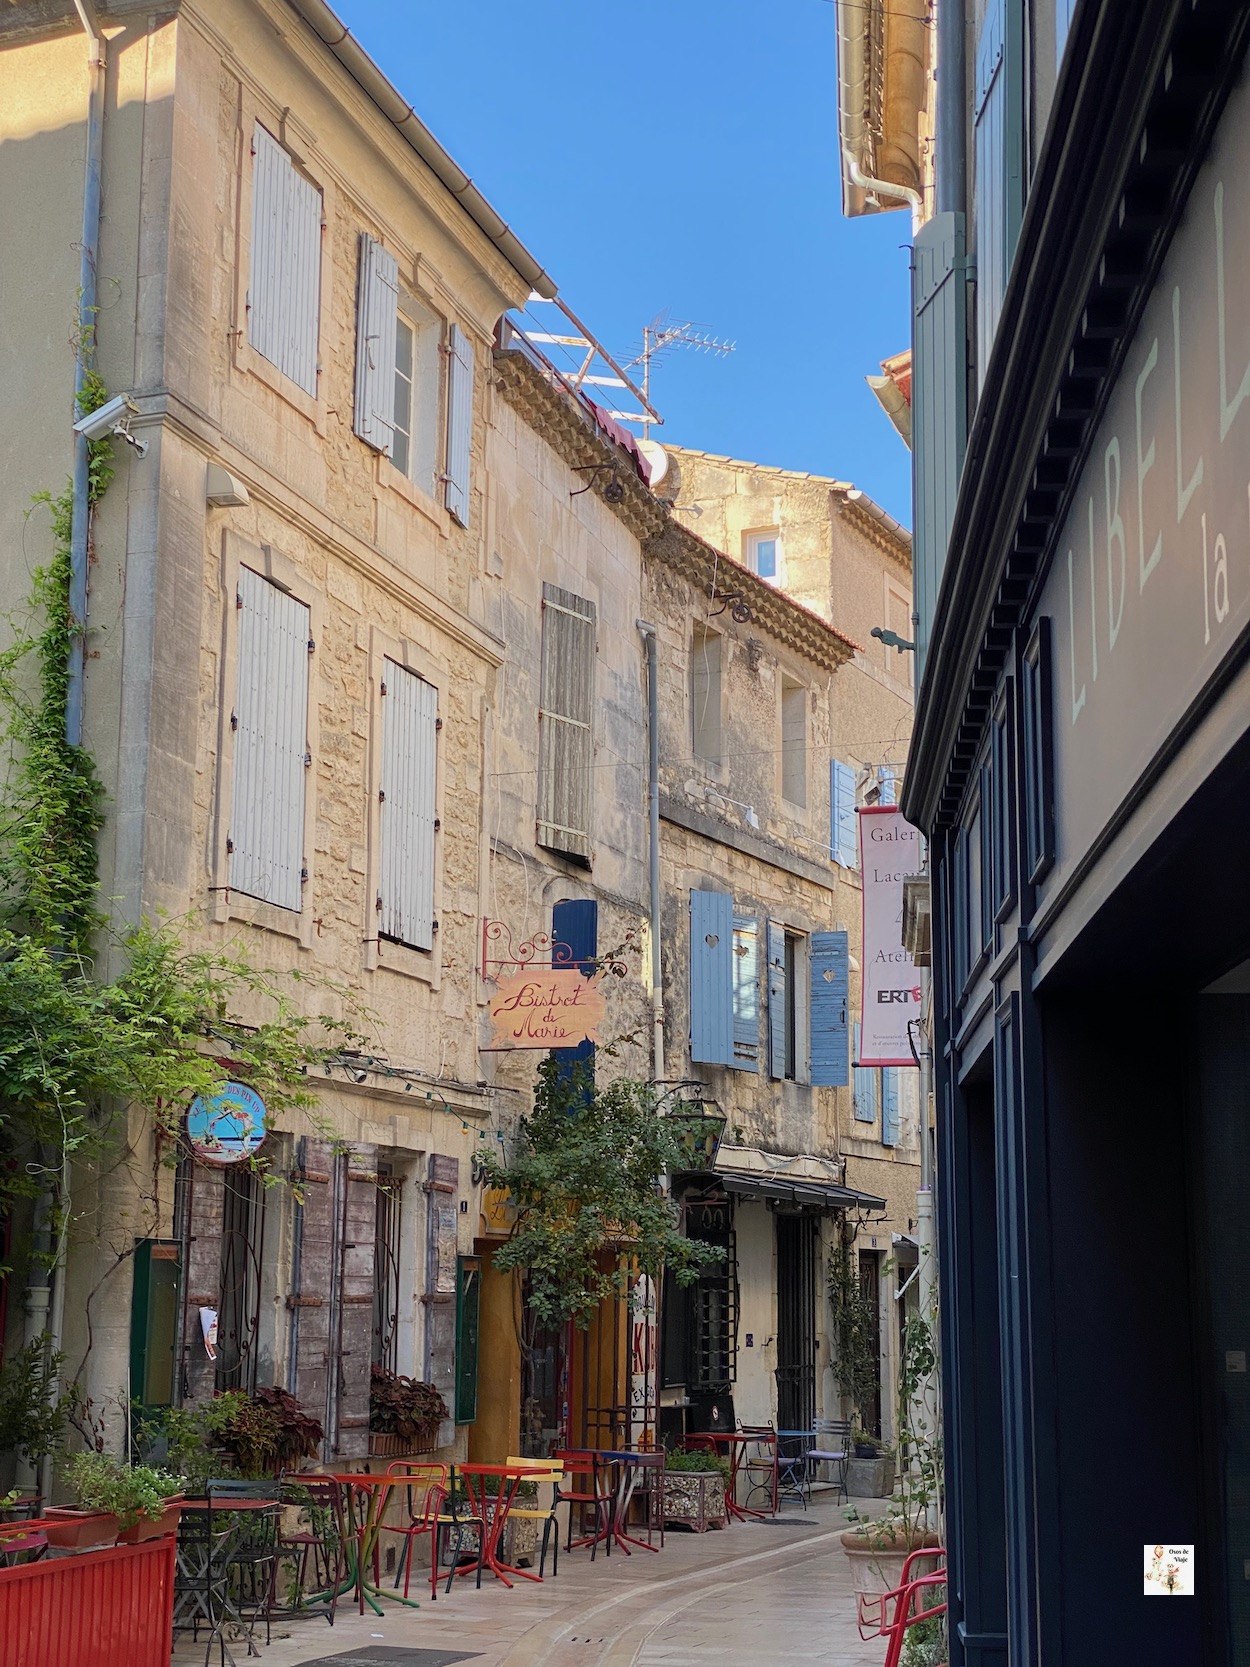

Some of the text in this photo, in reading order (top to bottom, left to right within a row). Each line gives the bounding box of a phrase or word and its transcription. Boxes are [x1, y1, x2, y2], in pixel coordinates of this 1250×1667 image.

[1201, 512, 1230, 646] la
[493, 982, 587, 1017] Bistrot
[542, 1008, 566, 1023] de
[513, 1008, 580, 1038] Marie
